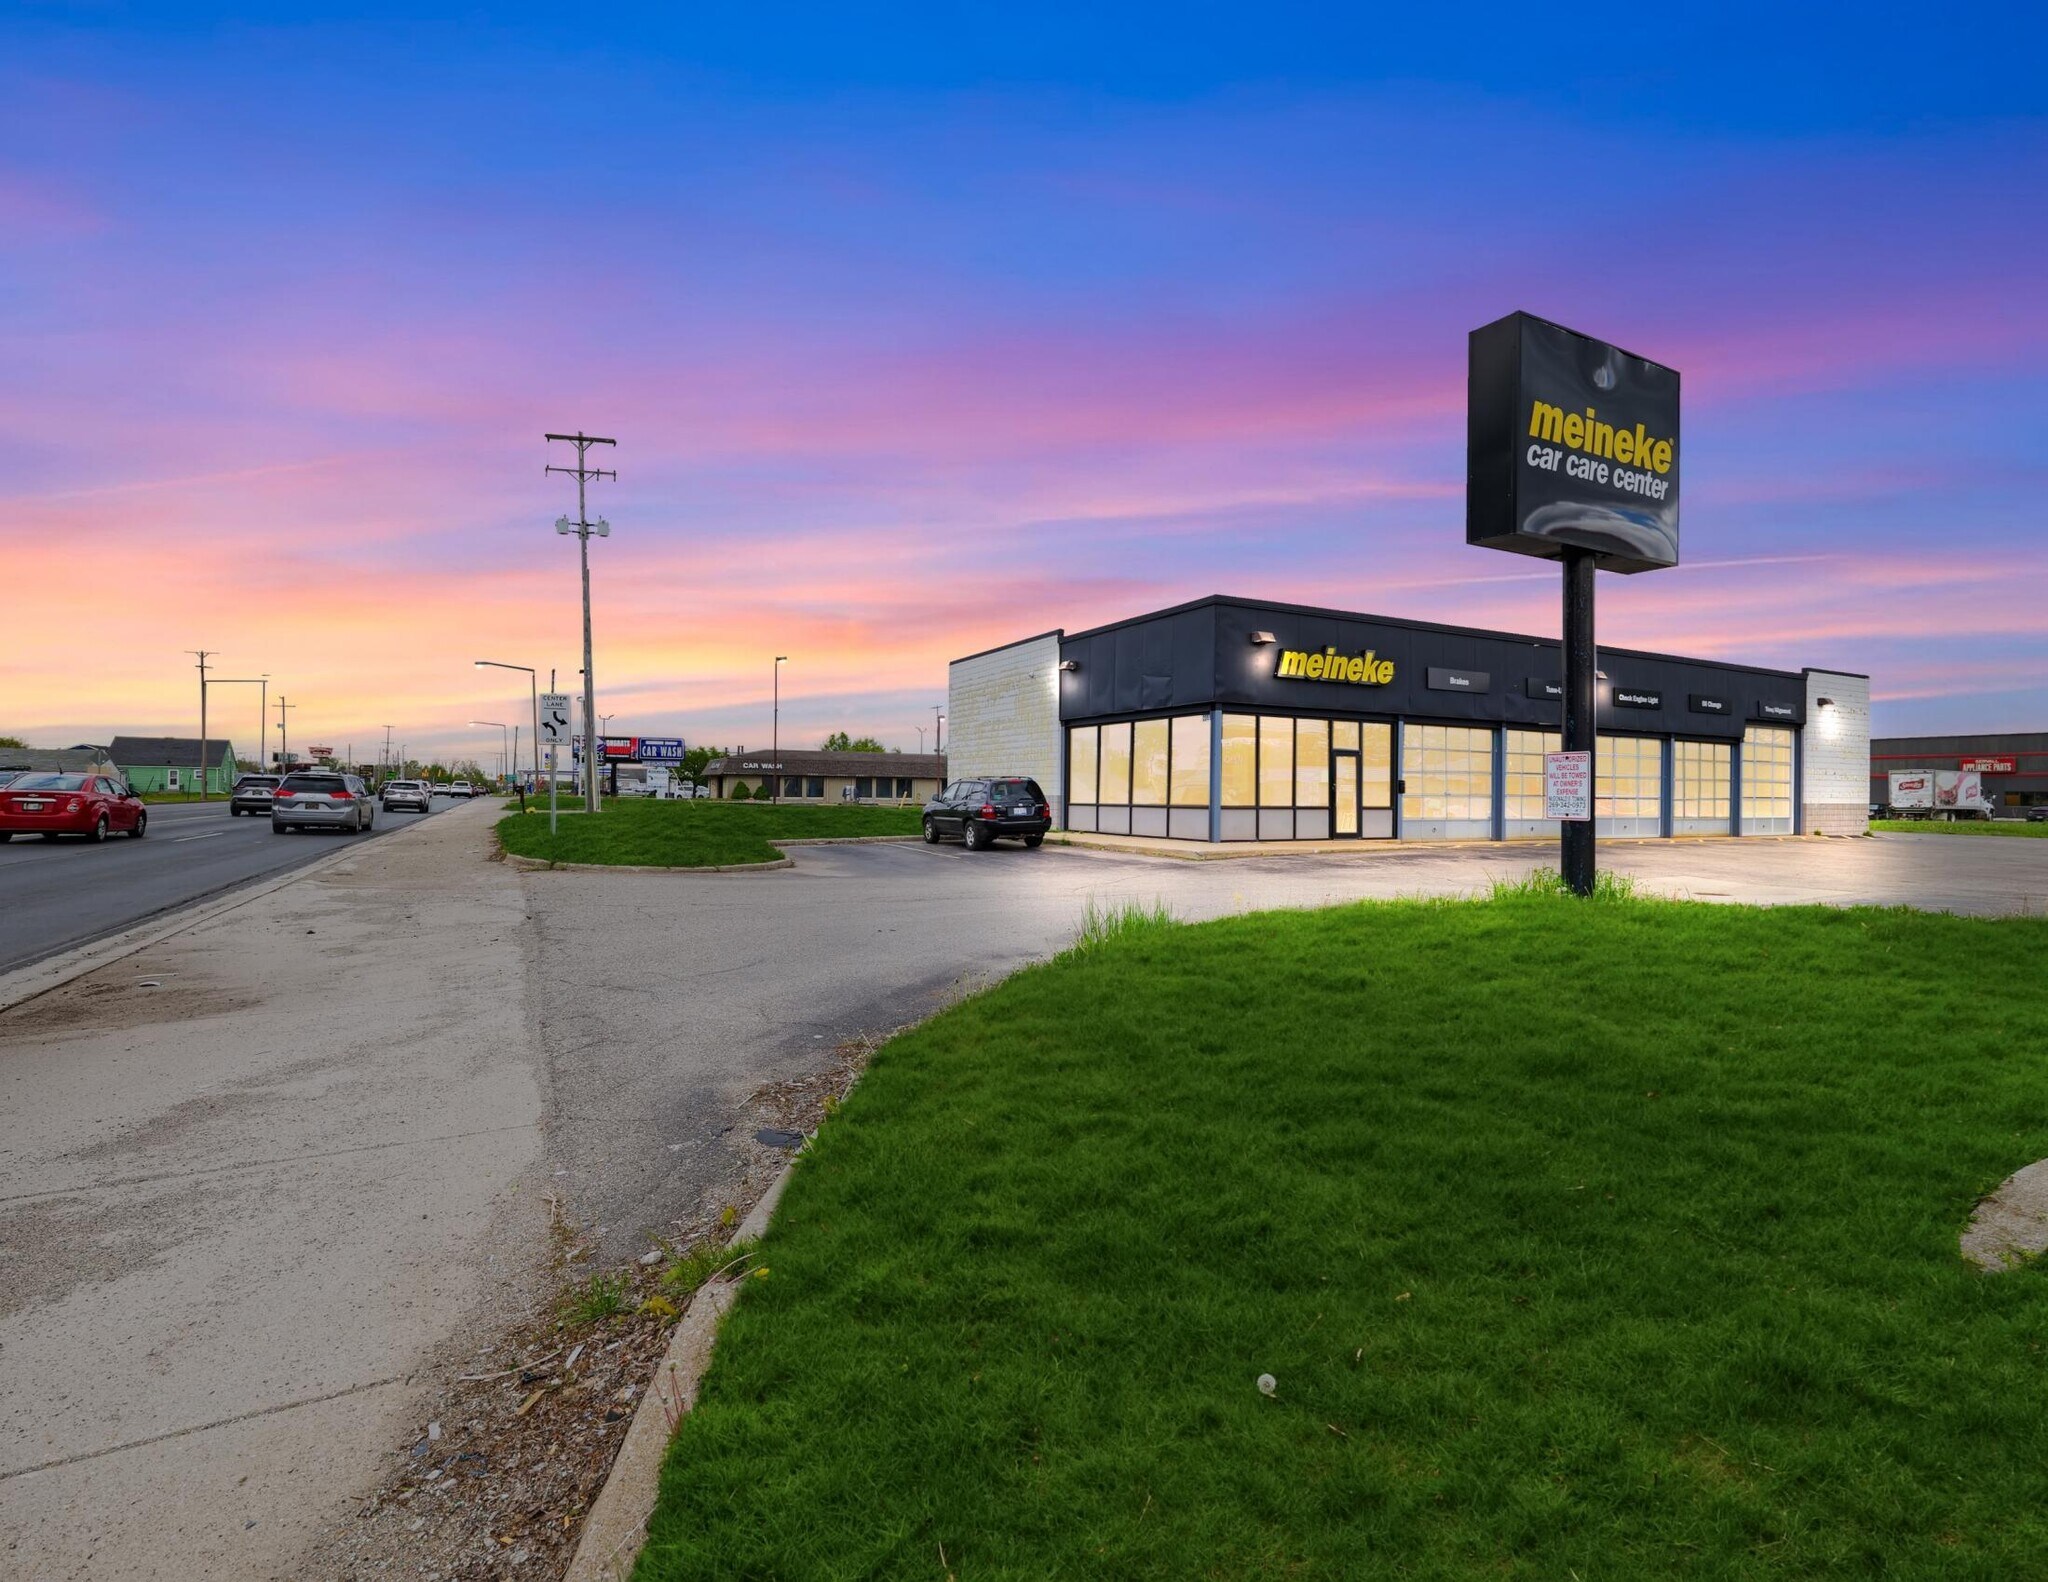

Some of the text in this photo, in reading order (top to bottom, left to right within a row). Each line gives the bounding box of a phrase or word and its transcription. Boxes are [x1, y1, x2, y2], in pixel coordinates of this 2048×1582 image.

[1526, 444, 1669, 499] car care center
[1277, 647, 1394, 685] meineke
[1449, 677, 1470, 686] Brakes
[1545, 685, 1563, 694] Tune-U
[1633, 695, 1647, 704] Engine
[1647, 696, 1659, 704] Light
[1708, 700, 1722, 709] Change
[642, 745, 656, 757] CAR
[659, 746, 682, 757] WASH
[1962, 762, 2012, 771] APPLIANCE PARTS
